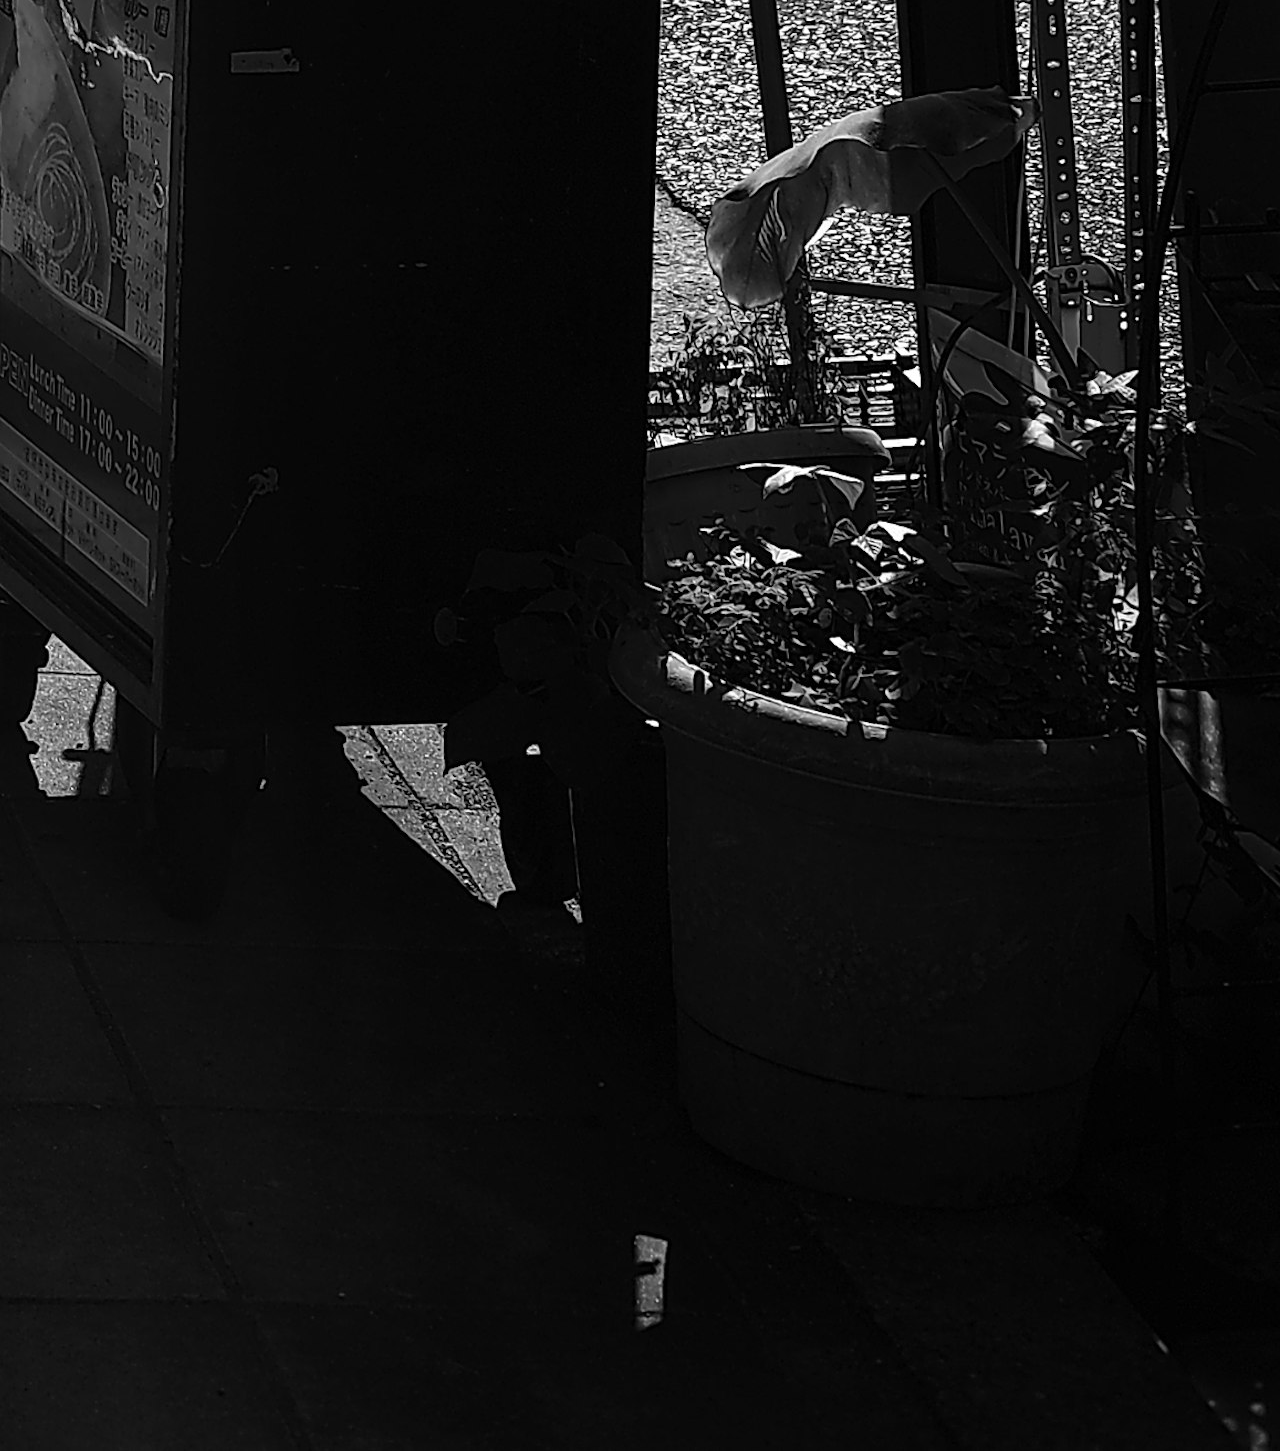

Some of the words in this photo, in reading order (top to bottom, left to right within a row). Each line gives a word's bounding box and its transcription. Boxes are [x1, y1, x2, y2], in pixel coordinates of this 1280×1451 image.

[29, 352, 57, 397] Lunch
[56, 374, 77, 412] Time
[28, 385, 55, 426] Dinner
[54, 406, 76, 444] Time
